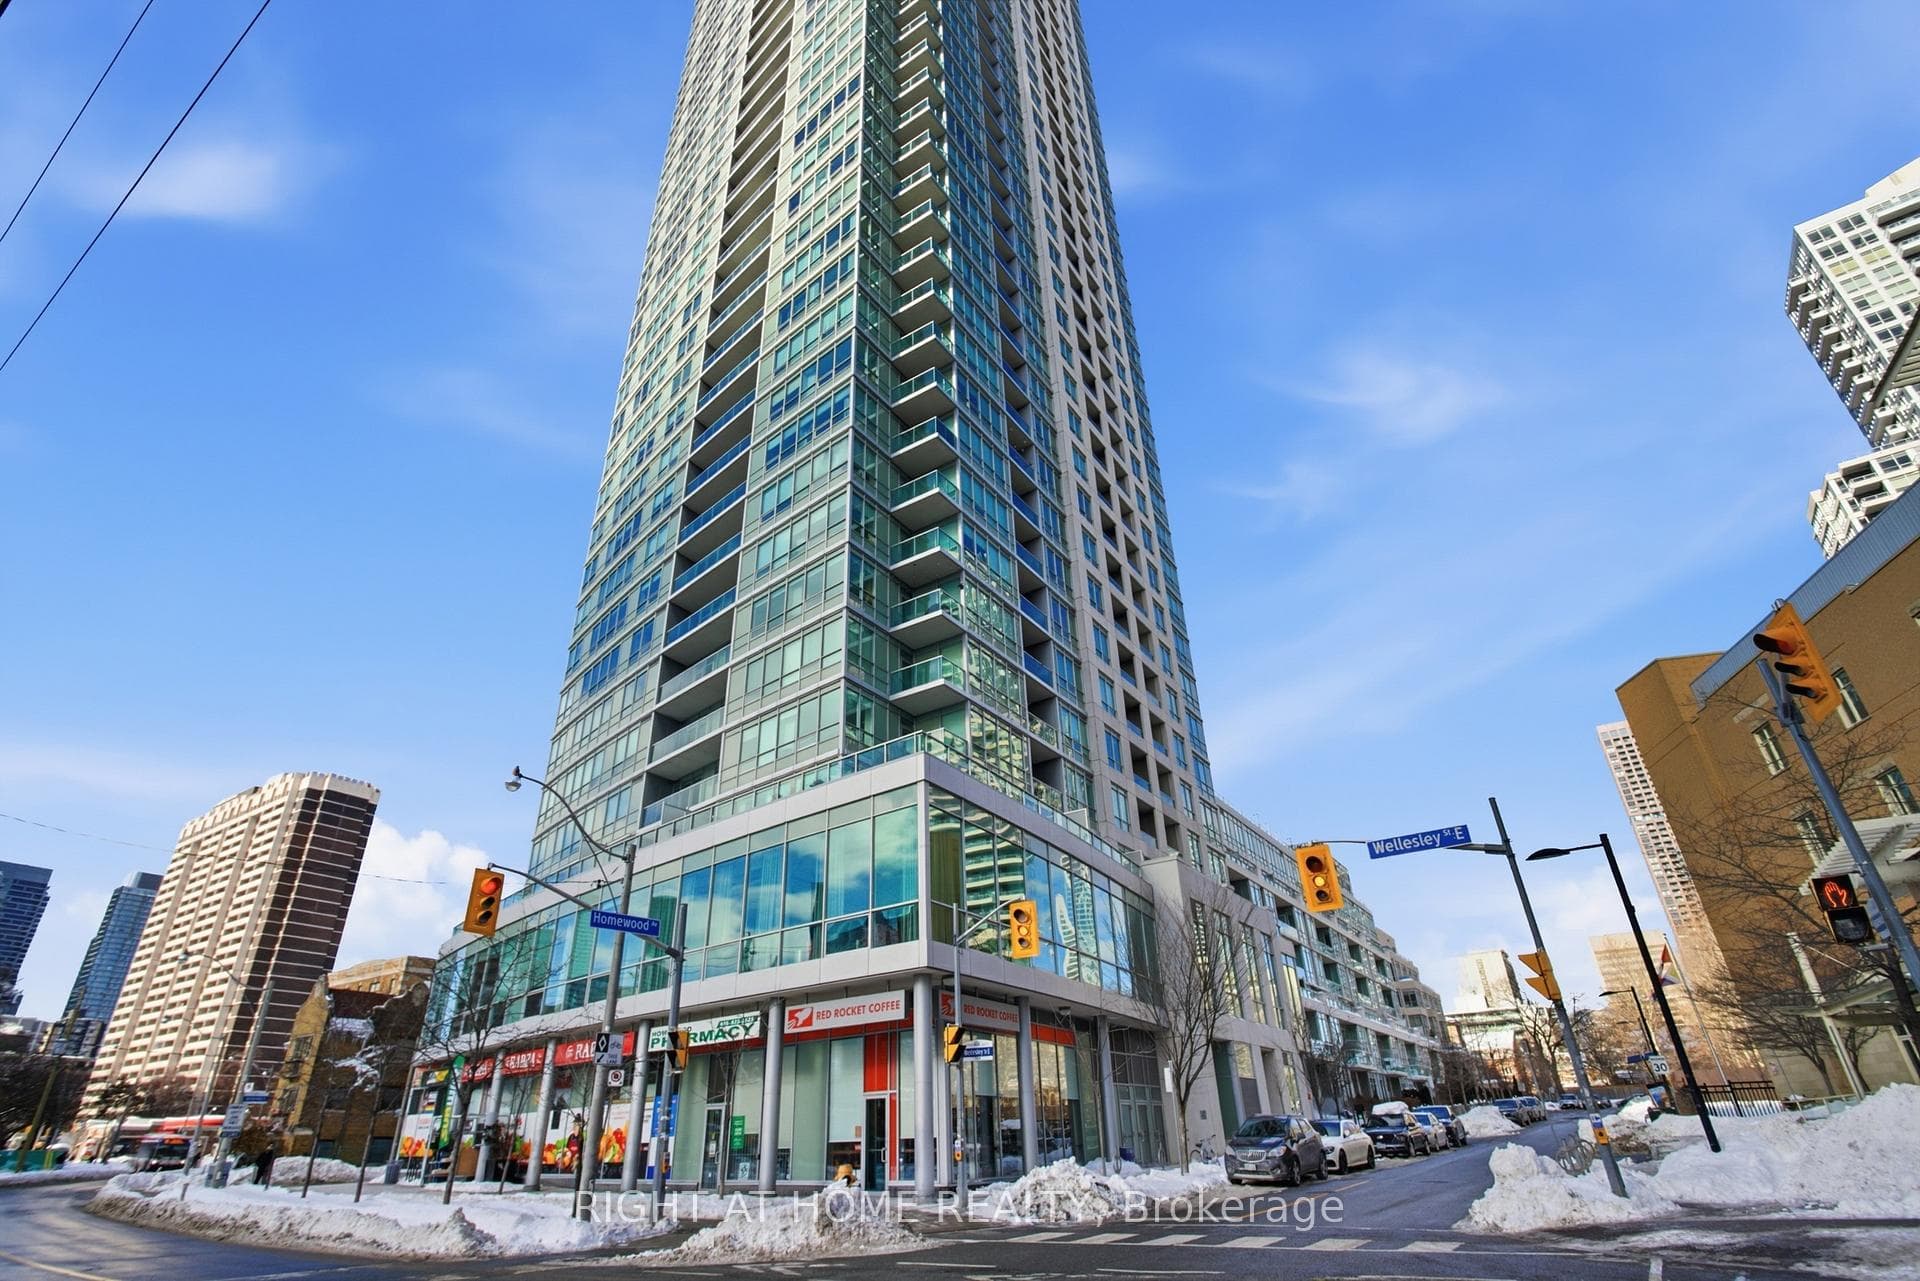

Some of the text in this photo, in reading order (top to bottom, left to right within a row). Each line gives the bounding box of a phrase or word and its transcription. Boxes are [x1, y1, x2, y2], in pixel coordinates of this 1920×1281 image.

[1372, 833, 1441, 854] Wellesley
[1454, 826, 1465, 840] E
[593, 912, 650, 930] Homewood
[816, 999, 901, 1021] RED ROCKET COFFEE
[963, 1003, 1018, 1023] RED ROCKET COFFEE
[651, 1023, 754, 1048] PHRMACY
[1653, 1062, 1668, 1072] 30
